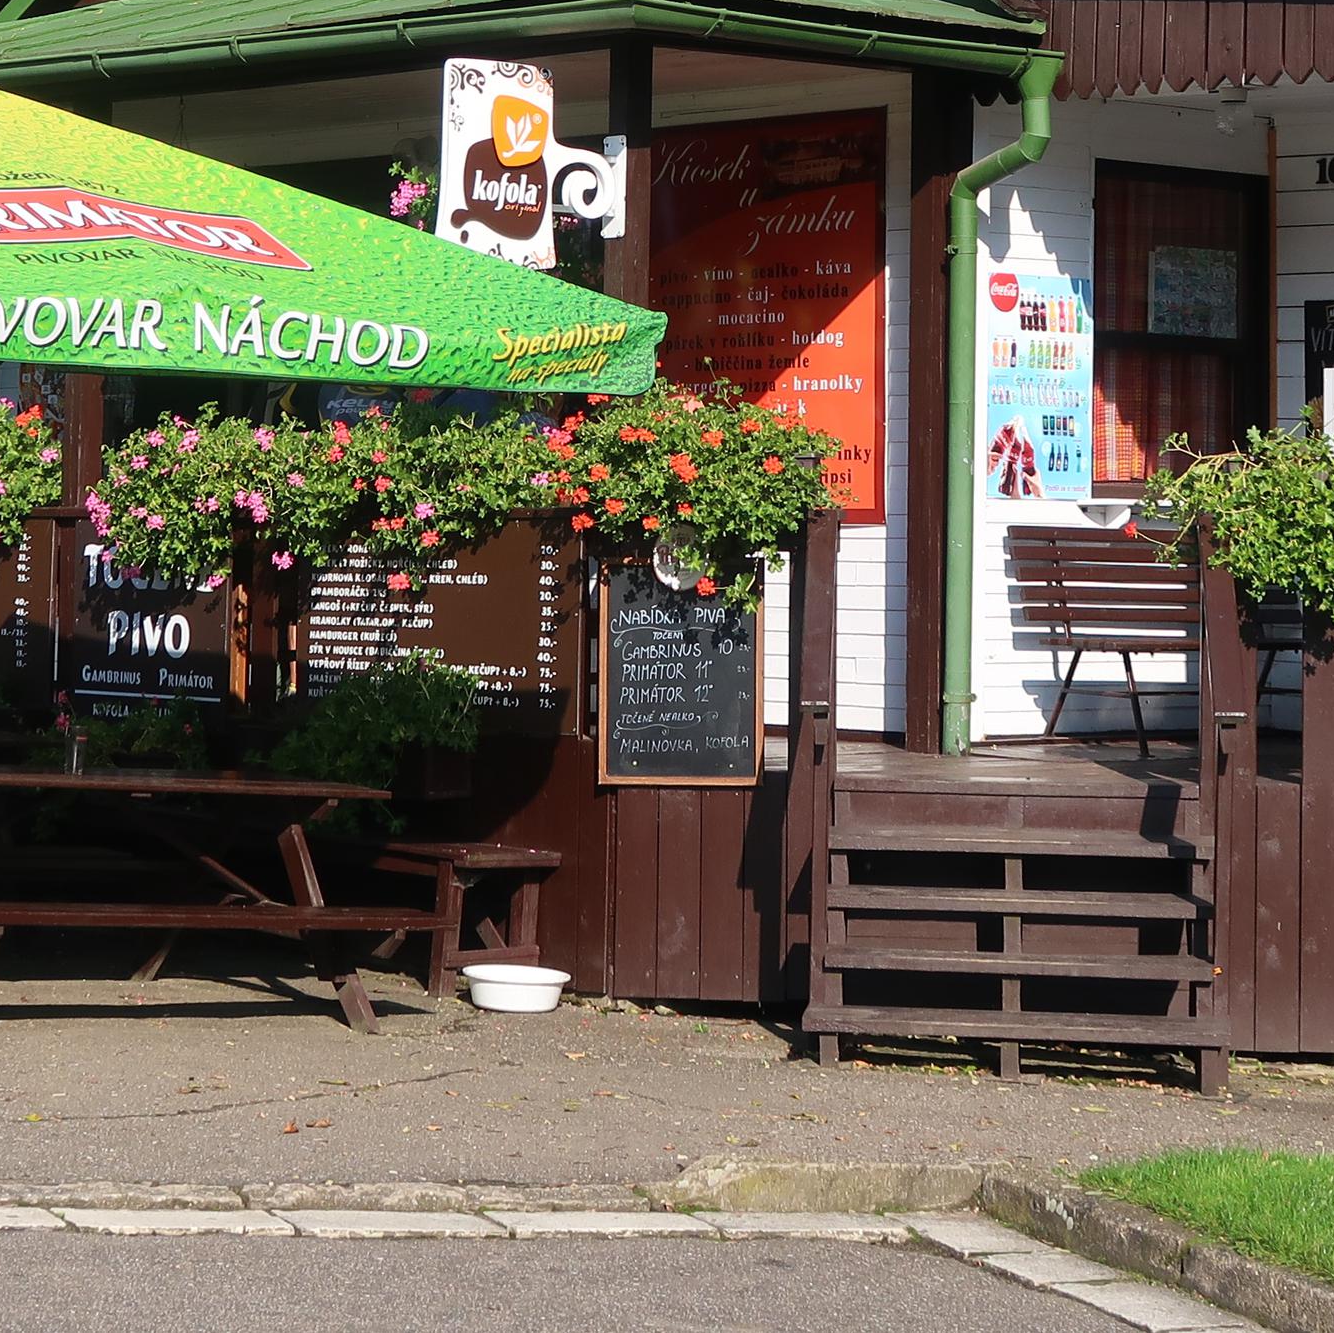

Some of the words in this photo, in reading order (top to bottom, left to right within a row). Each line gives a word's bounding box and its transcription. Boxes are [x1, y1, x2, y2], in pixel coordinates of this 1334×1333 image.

[651, 138, 750, 186] Kiosek
[472, 170, 542, 210] kofola
[739, 187, 758, 208] u
[504, 202, 542, 216] original
[738, 195, 855, 257] zámku
[13, 248, 145, 265] PIVOVAR
[703, 266, 733, 282] víno
[816, 258, 852, 276] káva
[747, 285, 769, 304] čaj
[781, 283, 850, 300] čokoláda
[718, 310, 785, 326] mocacino
[193, 295, 430, 371] NÁCHOD
[492, 321, 627, 365] Specialista
[722, 331, 774, 349] rohlíku
[791, 330, 844, 348] hotdog
[532, 350, 610, 385] speciály
[769, 353, 810, 369] žemle
[793, 375, 863, 393] hranolky
[540, 560, 559, 571] 30,-
[429, 572, 454, 584] KŘEN,
[456, 572, 488, 585] CHLÉB)
[539, 575, 559, 586] 40,-
[539, 591, 559, 602] 20,-
[310, 599, 340, 611] LANGOŠ
[414, 600, 434, 614] SÝR)
[541, 606, 558, 617] 35,-
[619, 605, 682, 627] NABÍDKA
[694, 607, 726, 624] PIVA
[310, 616, 351, 627] HRANOLKY
[540, 622, 558, 632] 25,-
[108, 610, 190, 659] PIVO
[309, 630, 359, 642] HAMBURGER
[538, 637, 557, 647] 30,-
[309, 642, 324, 655] SÝR
[333, 646, 363, 656] HOUSCE
[537, 652, 557, 663] 40,-
[622, 641, 702, 661] GAMBRINUS
[82, 665, 141, 685] GAMBRINUS
[159, 668, 213, 689] PRIMÁTOR
[308, 657, 345, 670] VEPŘOVÝ
[539, 668, 557, 678] 75,-
[622, 661, 687, 682] PRIMÁTOR
[539, 683, 556, 693] 75,-
[620, 683, 686, 705] PRIMÁTOR
[539, 699, 556, 709] 75,-
[620, 710, 655, 724] TOČENÉ
[659, 713, 694, 722] NEALKO
[706, 736, 749, 748] KOFOLA
